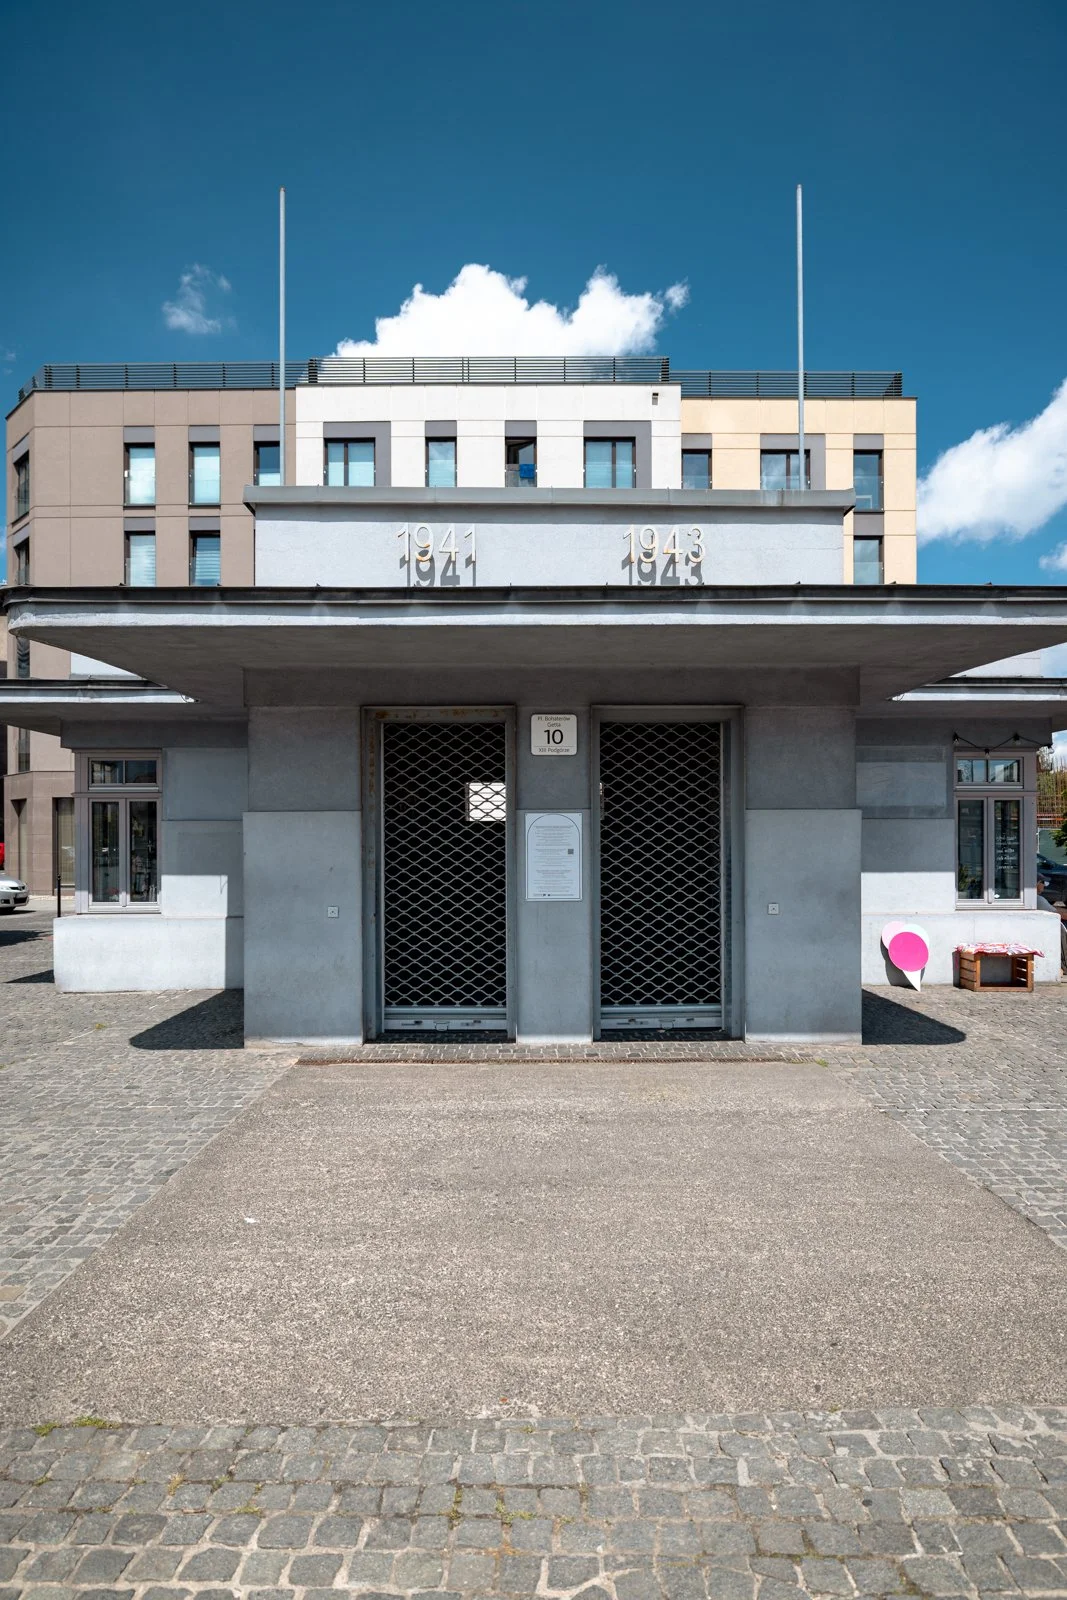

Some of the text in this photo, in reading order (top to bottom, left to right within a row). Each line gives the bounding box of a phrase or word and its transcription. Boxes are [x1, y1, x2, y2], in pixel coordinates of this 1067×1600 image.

[397, 523, 477, 562] 1941
[623, 524, 706, 563] 1943
[544, 729, 564, 745] 10
